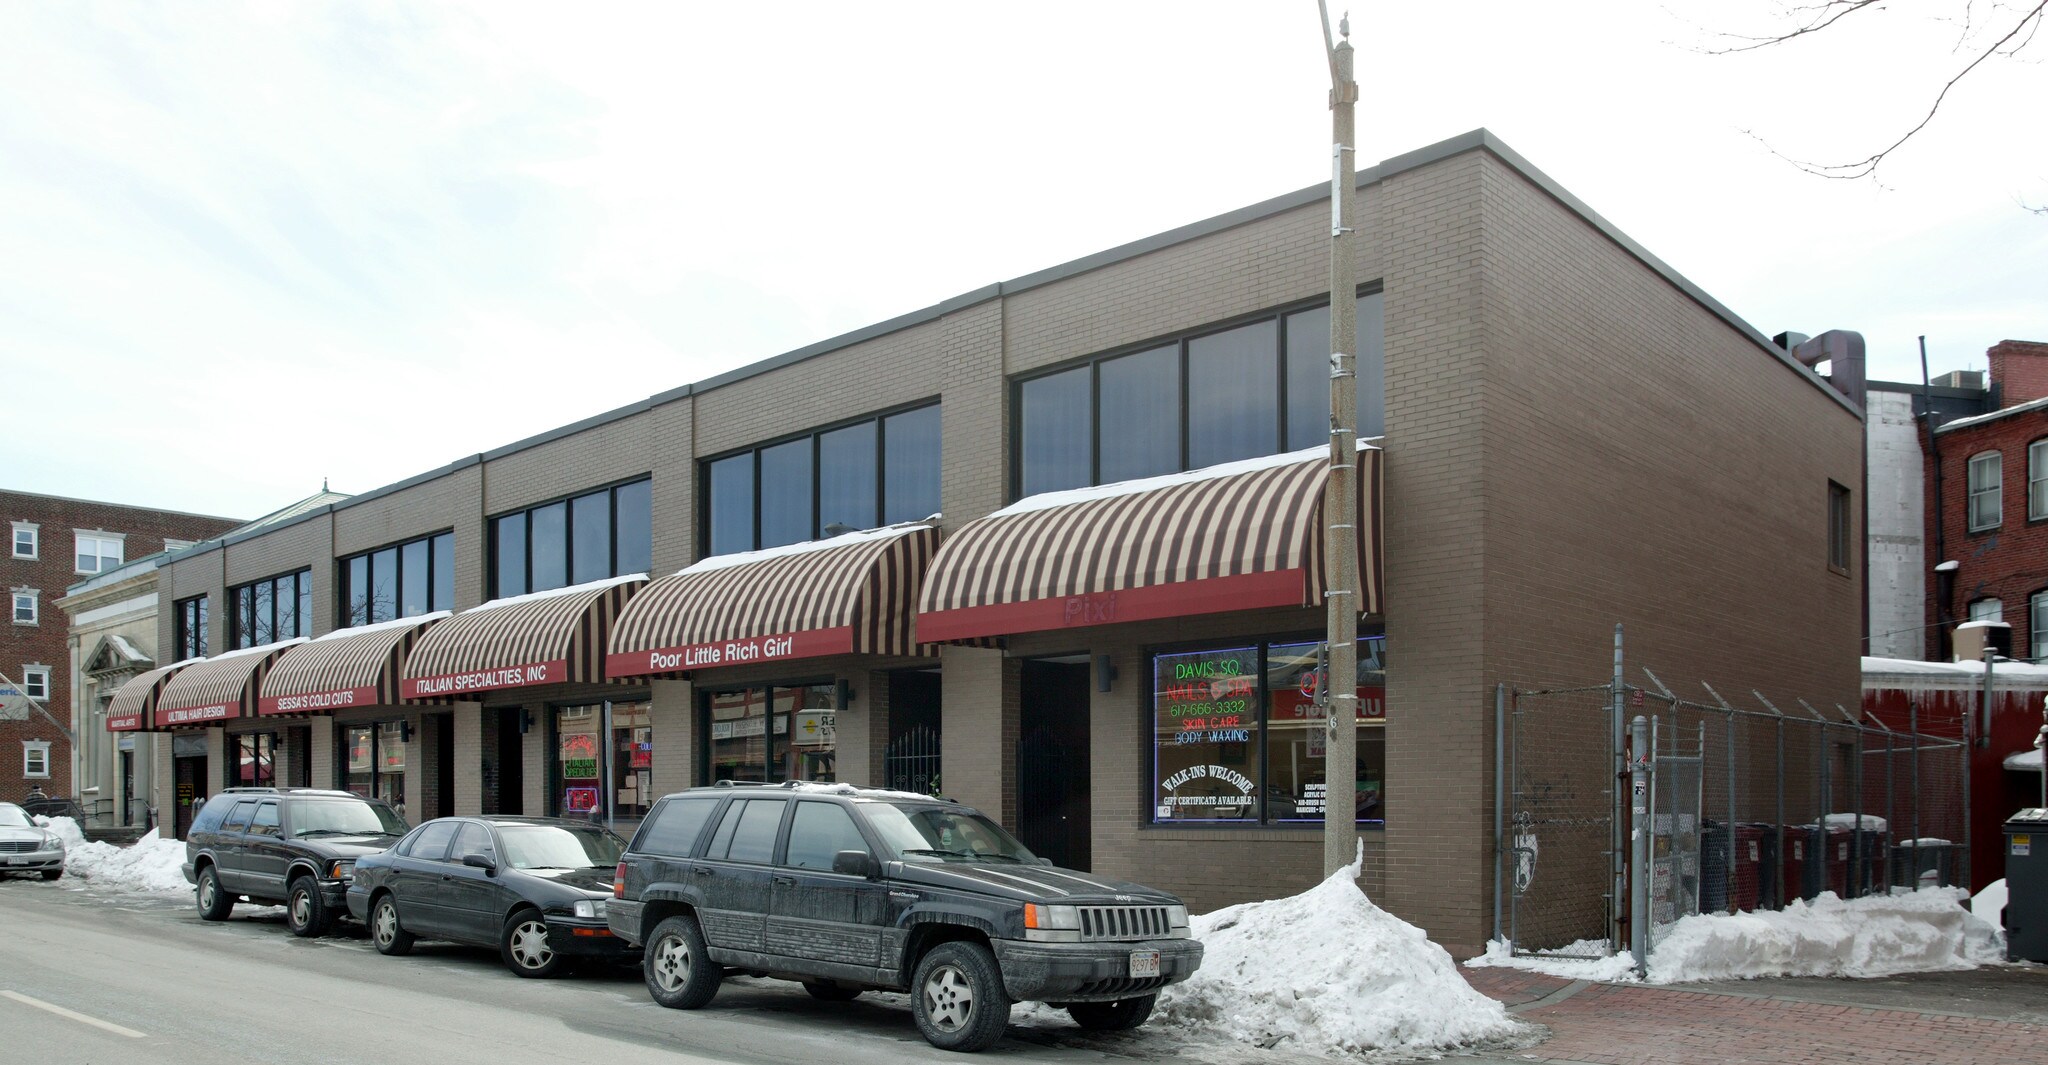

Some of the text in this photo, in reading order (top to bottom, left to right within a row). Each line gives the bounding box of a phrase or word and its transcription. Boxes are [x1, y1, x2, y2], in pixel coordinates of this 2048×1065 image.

[650, 636, 793, 669] Poor Little Rich Girl
[1175, 660, 1215, 680] DAVIS
[416, 664, 547, 694] ITALIAN SPECIALTIES, INC
[1166, 681, 1208, 701] NAILS
[1226, 679, 1254, 698] SPA
[277, 691, 354, 711] SESSA'S COLD CUTS
[1170, 700, 1246, 717] 617-666-3332
[168, 705, 226, 722] ULTIMA HAIR DESIGN
[1182, 715, 1240, 731] SKIN CARE
[1329, 716, 1337, 729] 6
[1174, 729, 1249, 744] BODY WAXING
[1161, 764, 1255, 794] WALK-INS WELCOME
[1163, 796, 1177, 806] GIFT
[1178, 796, 1217, 805] CERTIFICATE
[1217, 796, 1252, 805] AVAILABLE
[1114, 894, 1132, 902] Jeep
[1131, 958, 1148, 971] 9297
